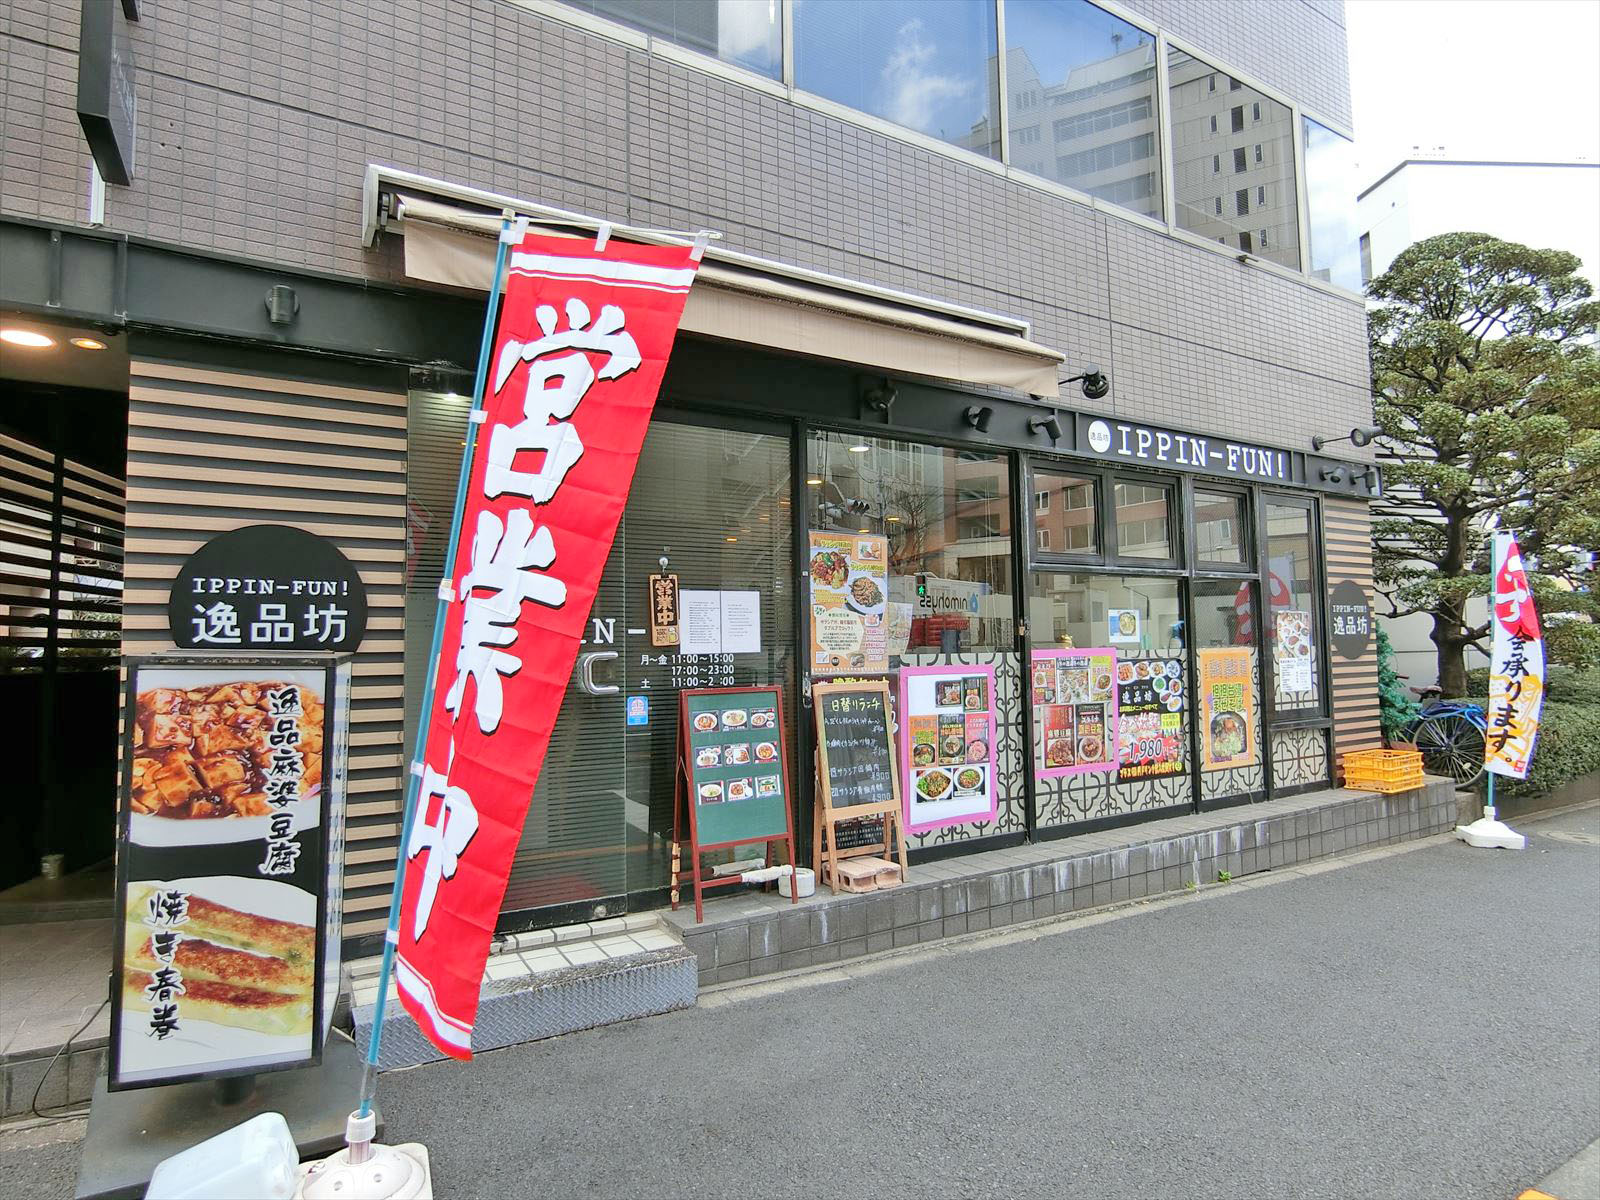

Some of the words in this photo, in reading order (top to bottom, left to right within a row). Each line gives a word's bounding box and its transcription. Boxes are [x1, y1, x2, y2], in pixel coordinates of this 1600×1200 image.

[1117, 425, 1284, 479] IPPIN-FUN!
[192, 577, 350, 596] IPPIN-FUN!
[655, 579, 675, 626] 営業中
[192, 601, 349, 644] 逸品坊
[1333, 616, 1368, 635] 逸品坊
[640, 678, 651, 689] 土
[831, 697, 881, 712] 日替りランチ
[260, 686, 303, 876] 逸品麻婆豆腐
[148, 889, 190, 1041] 焼き春巻
